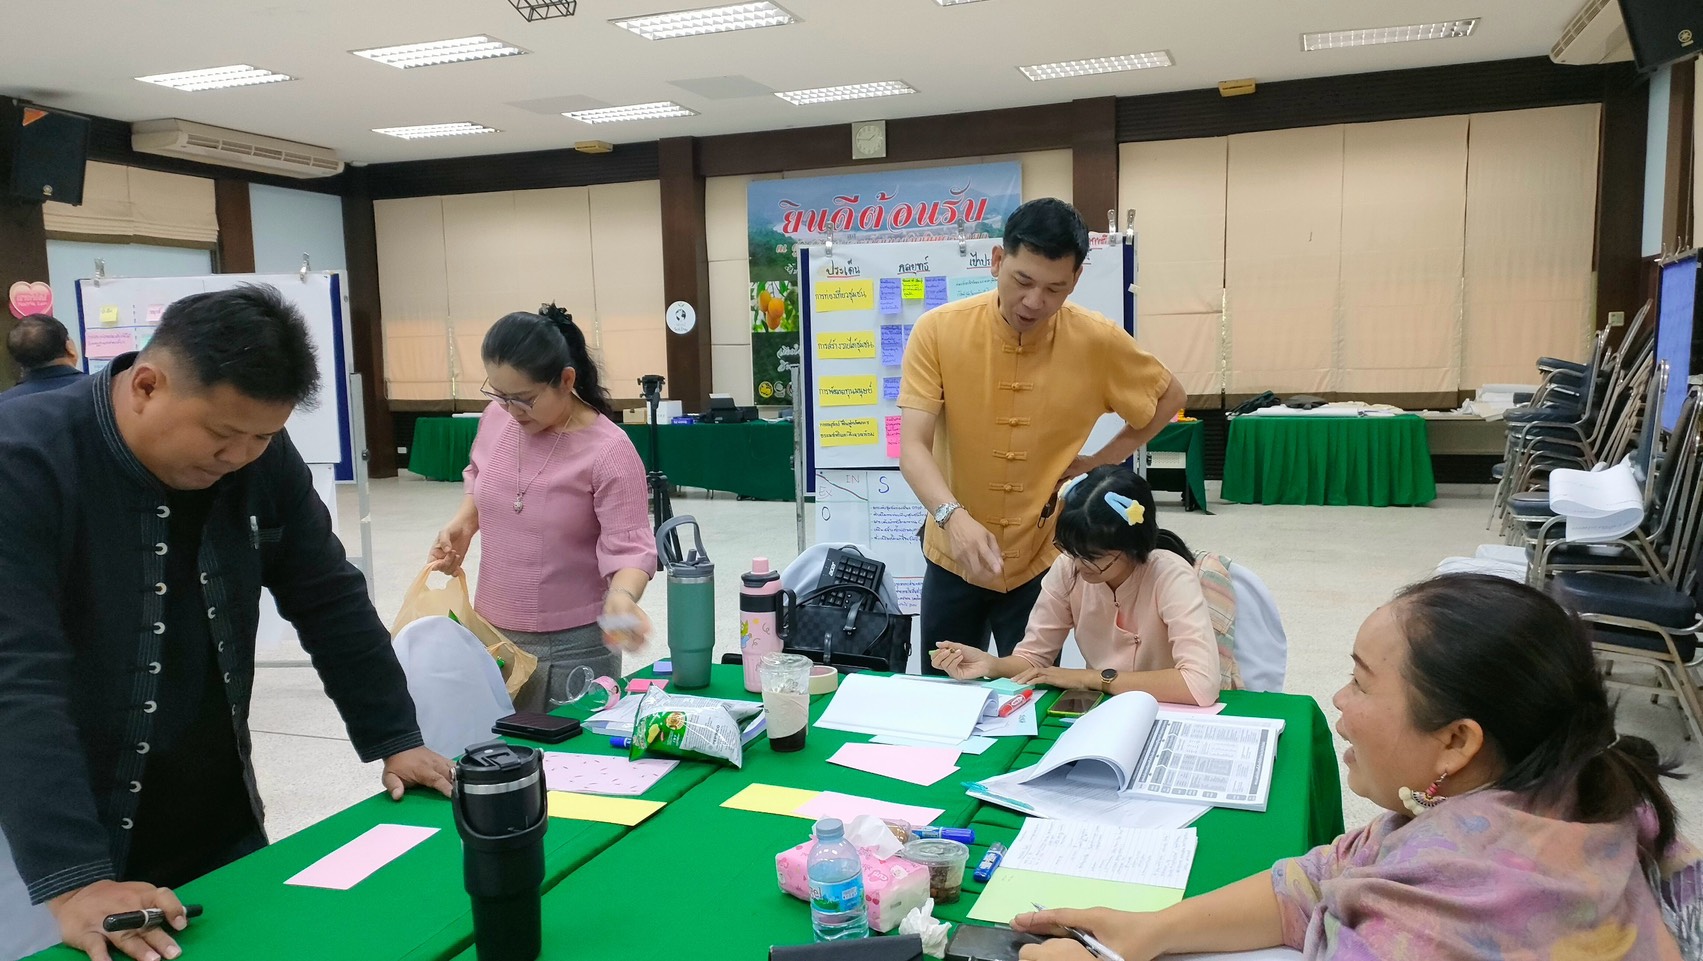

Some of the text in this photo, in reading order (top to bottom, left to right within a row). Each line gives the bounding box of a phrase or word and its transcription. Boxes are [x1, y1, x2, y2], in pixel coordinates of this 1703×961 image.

[778, 178, 988, 234] ยินดีต้อนรับ
[826, 259, 861, 276] ประเด็น
[846, 474, 860, 484] IN
[878, 476, 890, 494] S
